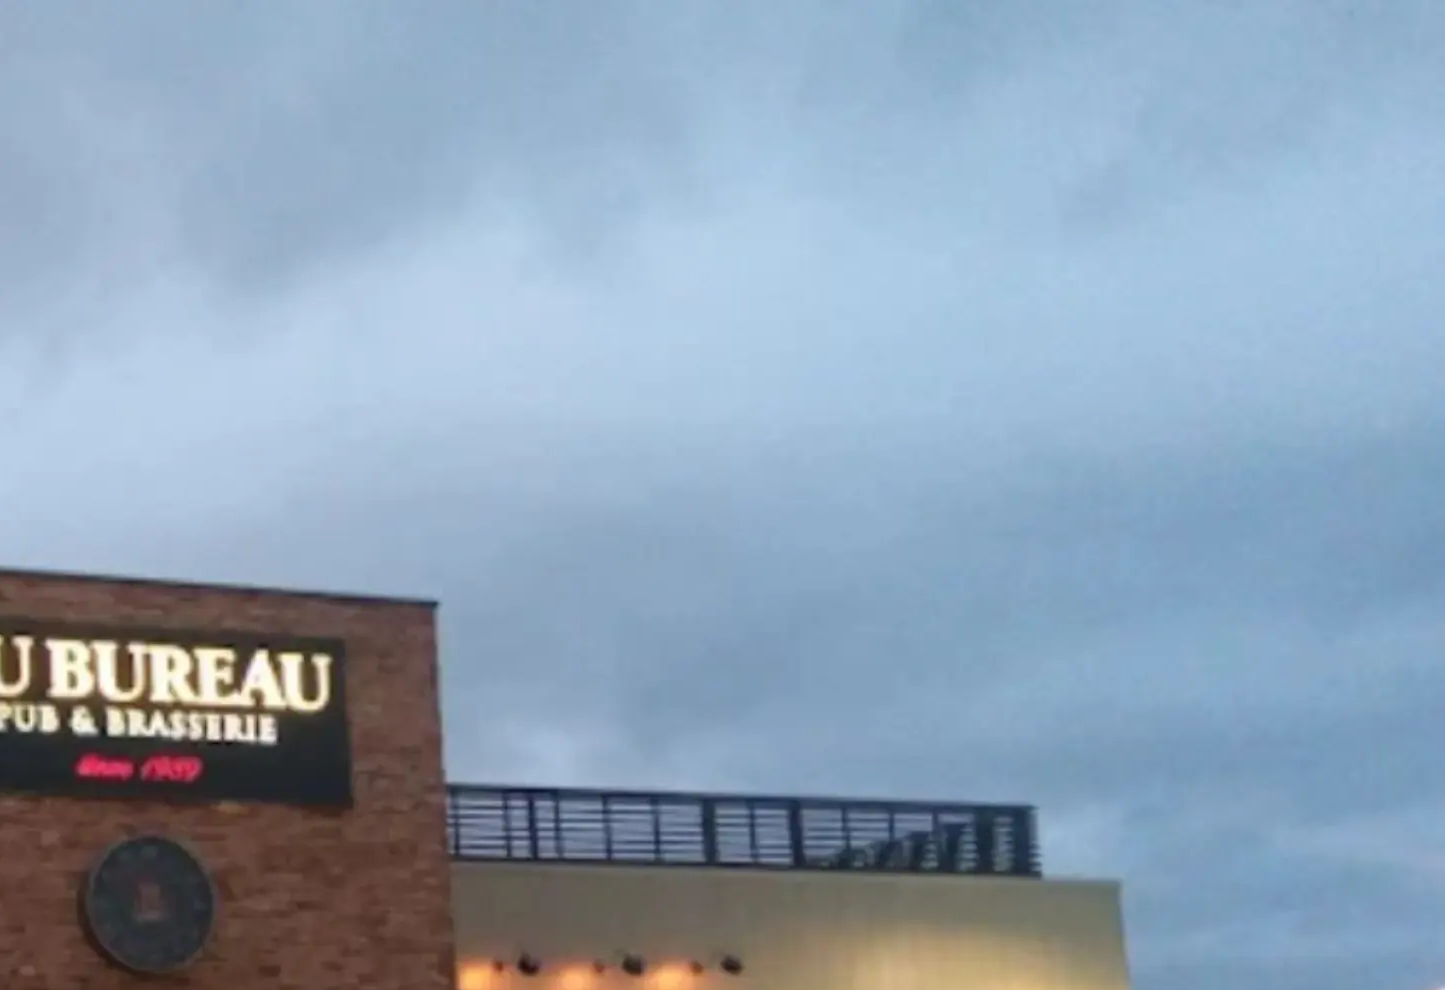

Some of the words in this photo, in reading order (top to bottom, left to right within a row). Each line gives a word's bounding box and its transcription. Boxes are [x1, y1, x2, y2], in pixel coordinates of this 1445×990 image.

[44, 638, 332, 712] BUREAU
[69, 704, 98, 736] &
[106, 705, 278, 744] BRASSERIE
